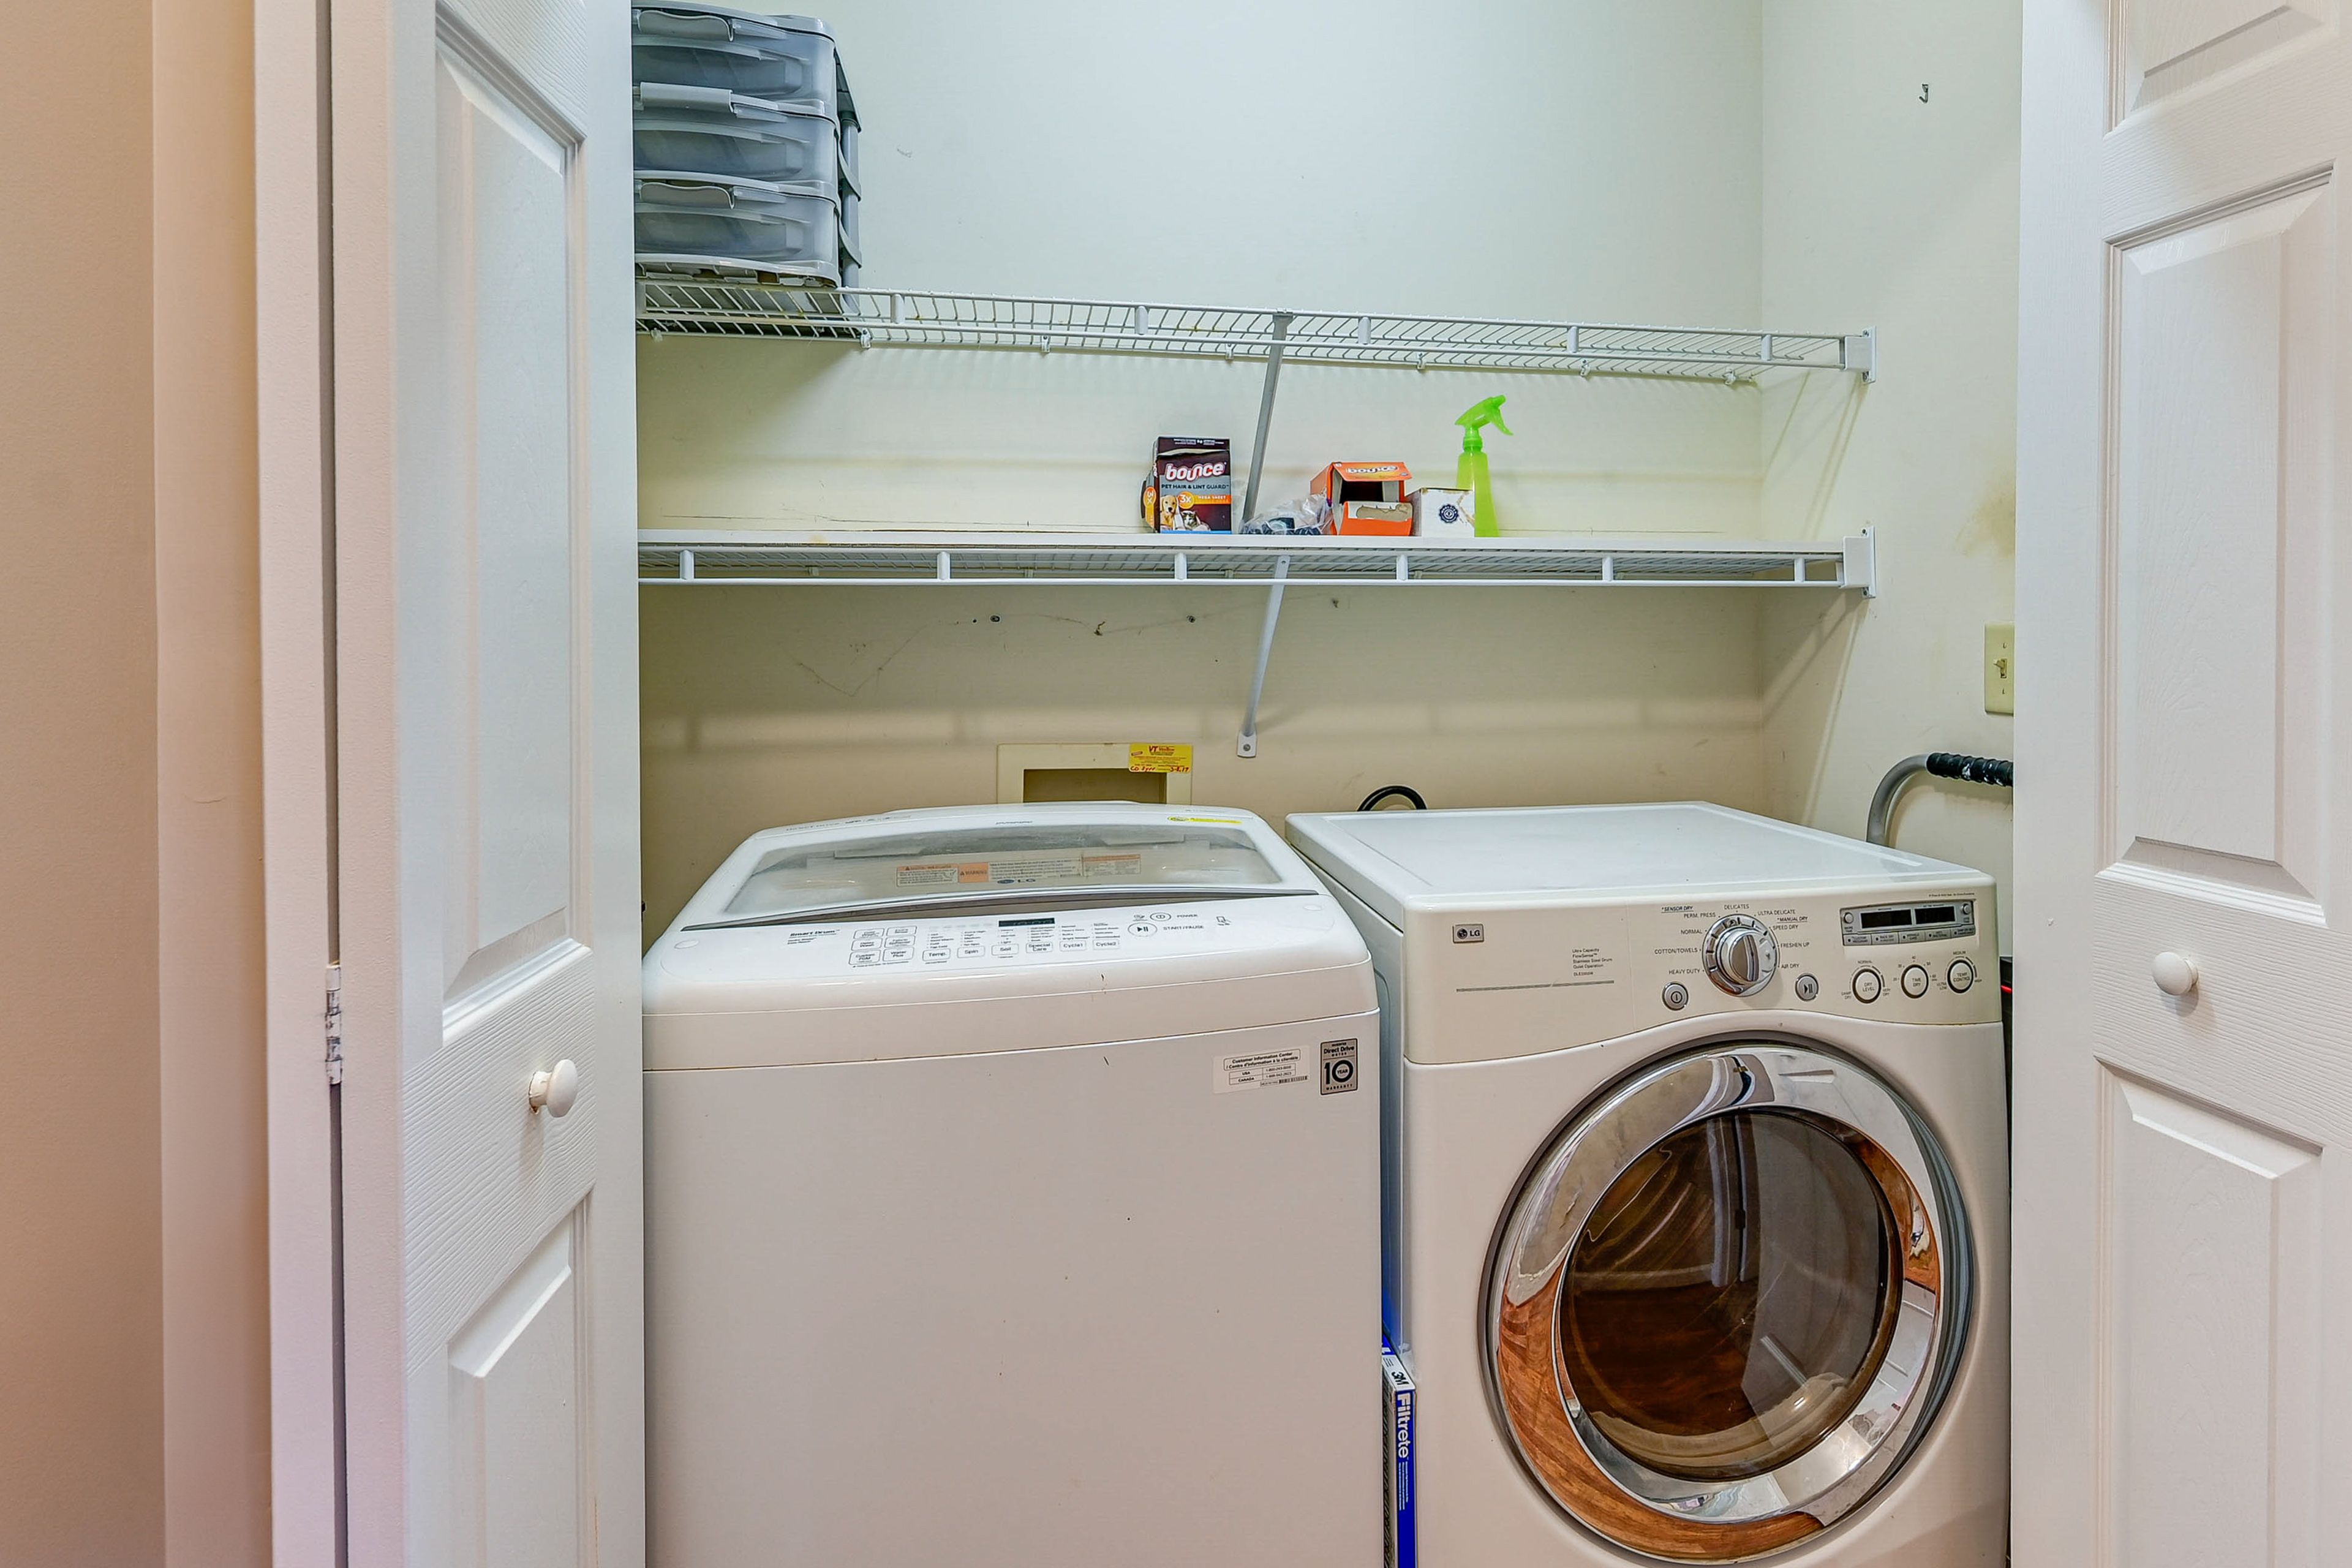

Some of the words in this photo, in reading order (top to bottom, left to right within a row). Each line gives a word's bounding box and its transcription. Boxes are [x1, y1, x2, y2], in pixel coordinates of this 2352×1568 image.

[1165, 462, 1225, 482] bounce
[1324, 1060, 1354, 1085] 10
[1391, 1371, 1410, 1385] 3M
[1397, 1392, 1411, 1459] Filtrete
